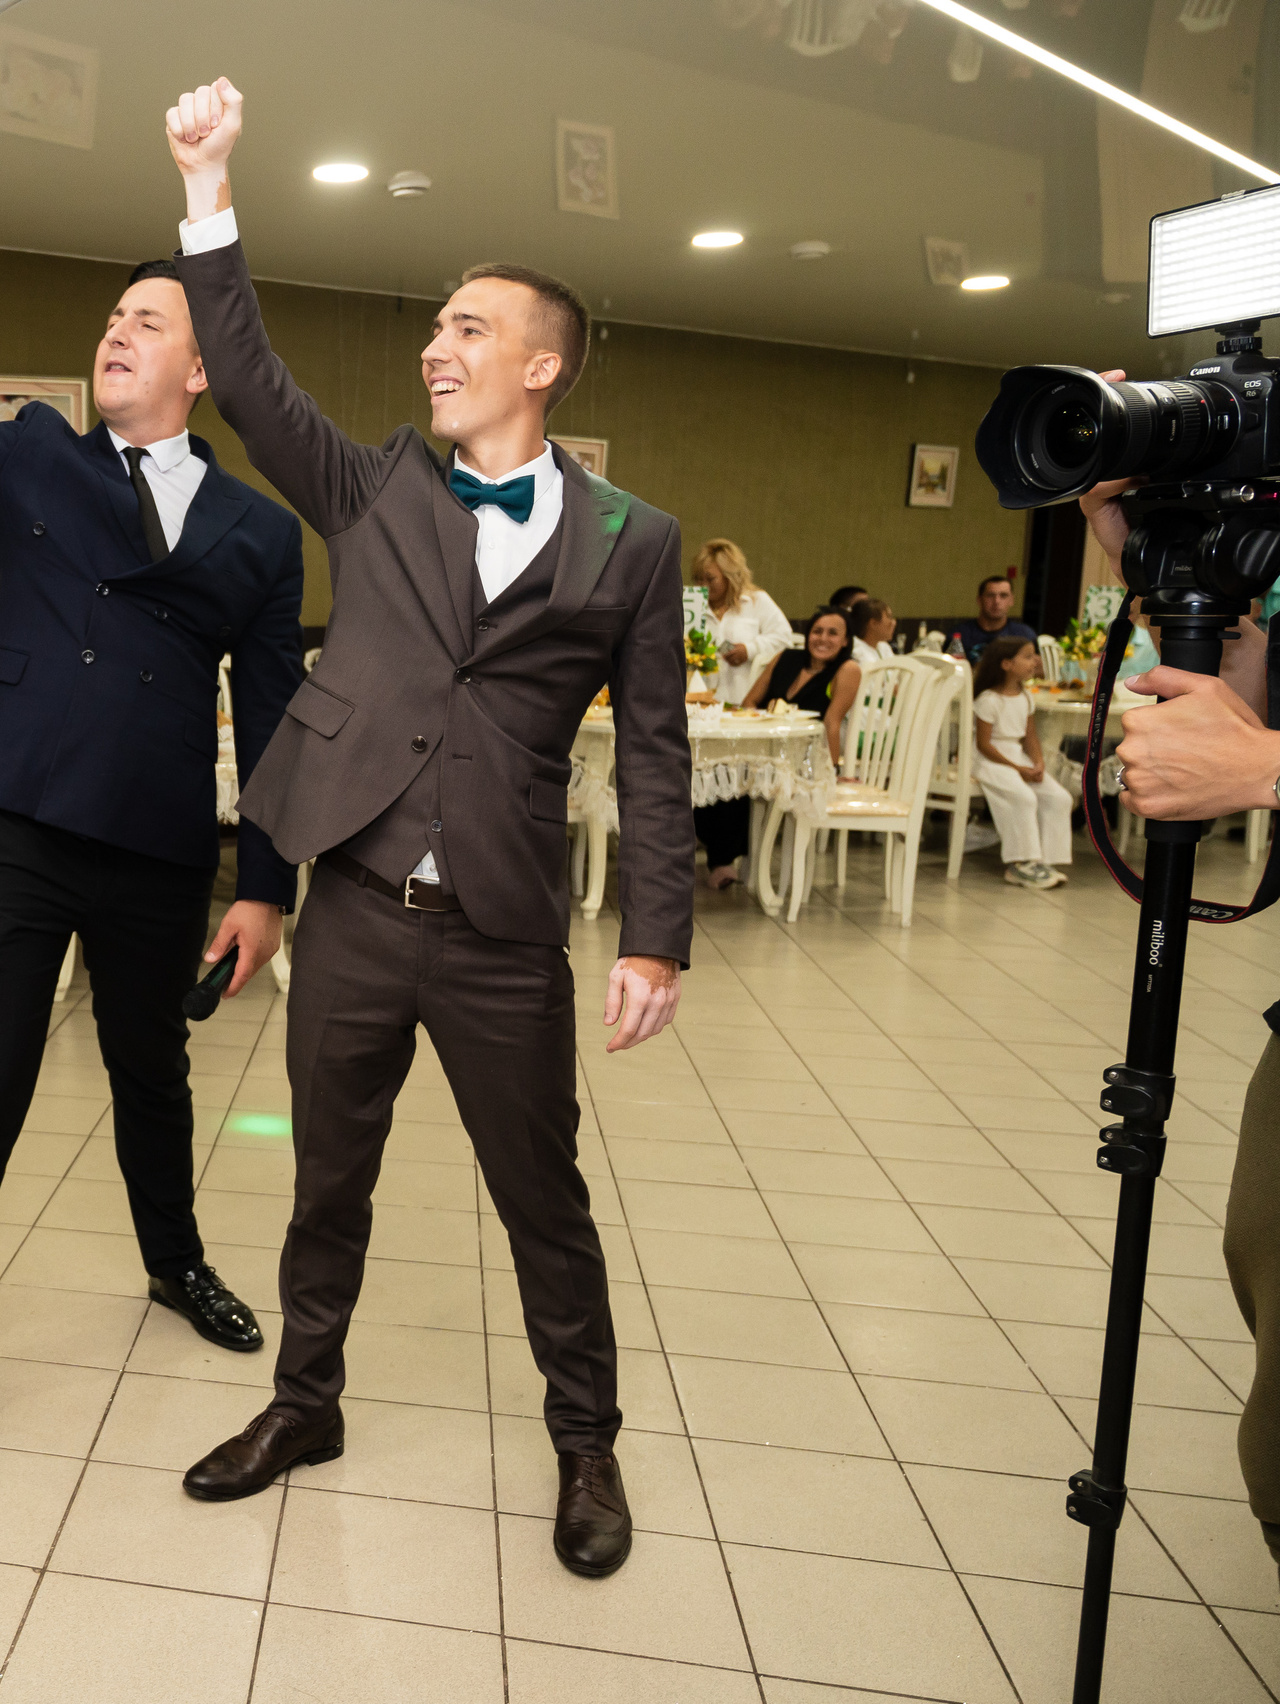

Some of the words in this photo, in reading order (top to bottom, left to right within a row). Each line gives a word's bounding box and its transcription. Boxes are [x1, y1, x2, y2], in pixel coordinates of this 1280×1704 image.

[1190, 366, 1221, 376] Canon
[1244, 380, 1261, 388] EOS
[1094, 595, 1112, 619] 3
[1189, 905, 1234, 919] Can
[1149, 920, 1165, 966] miliboo
